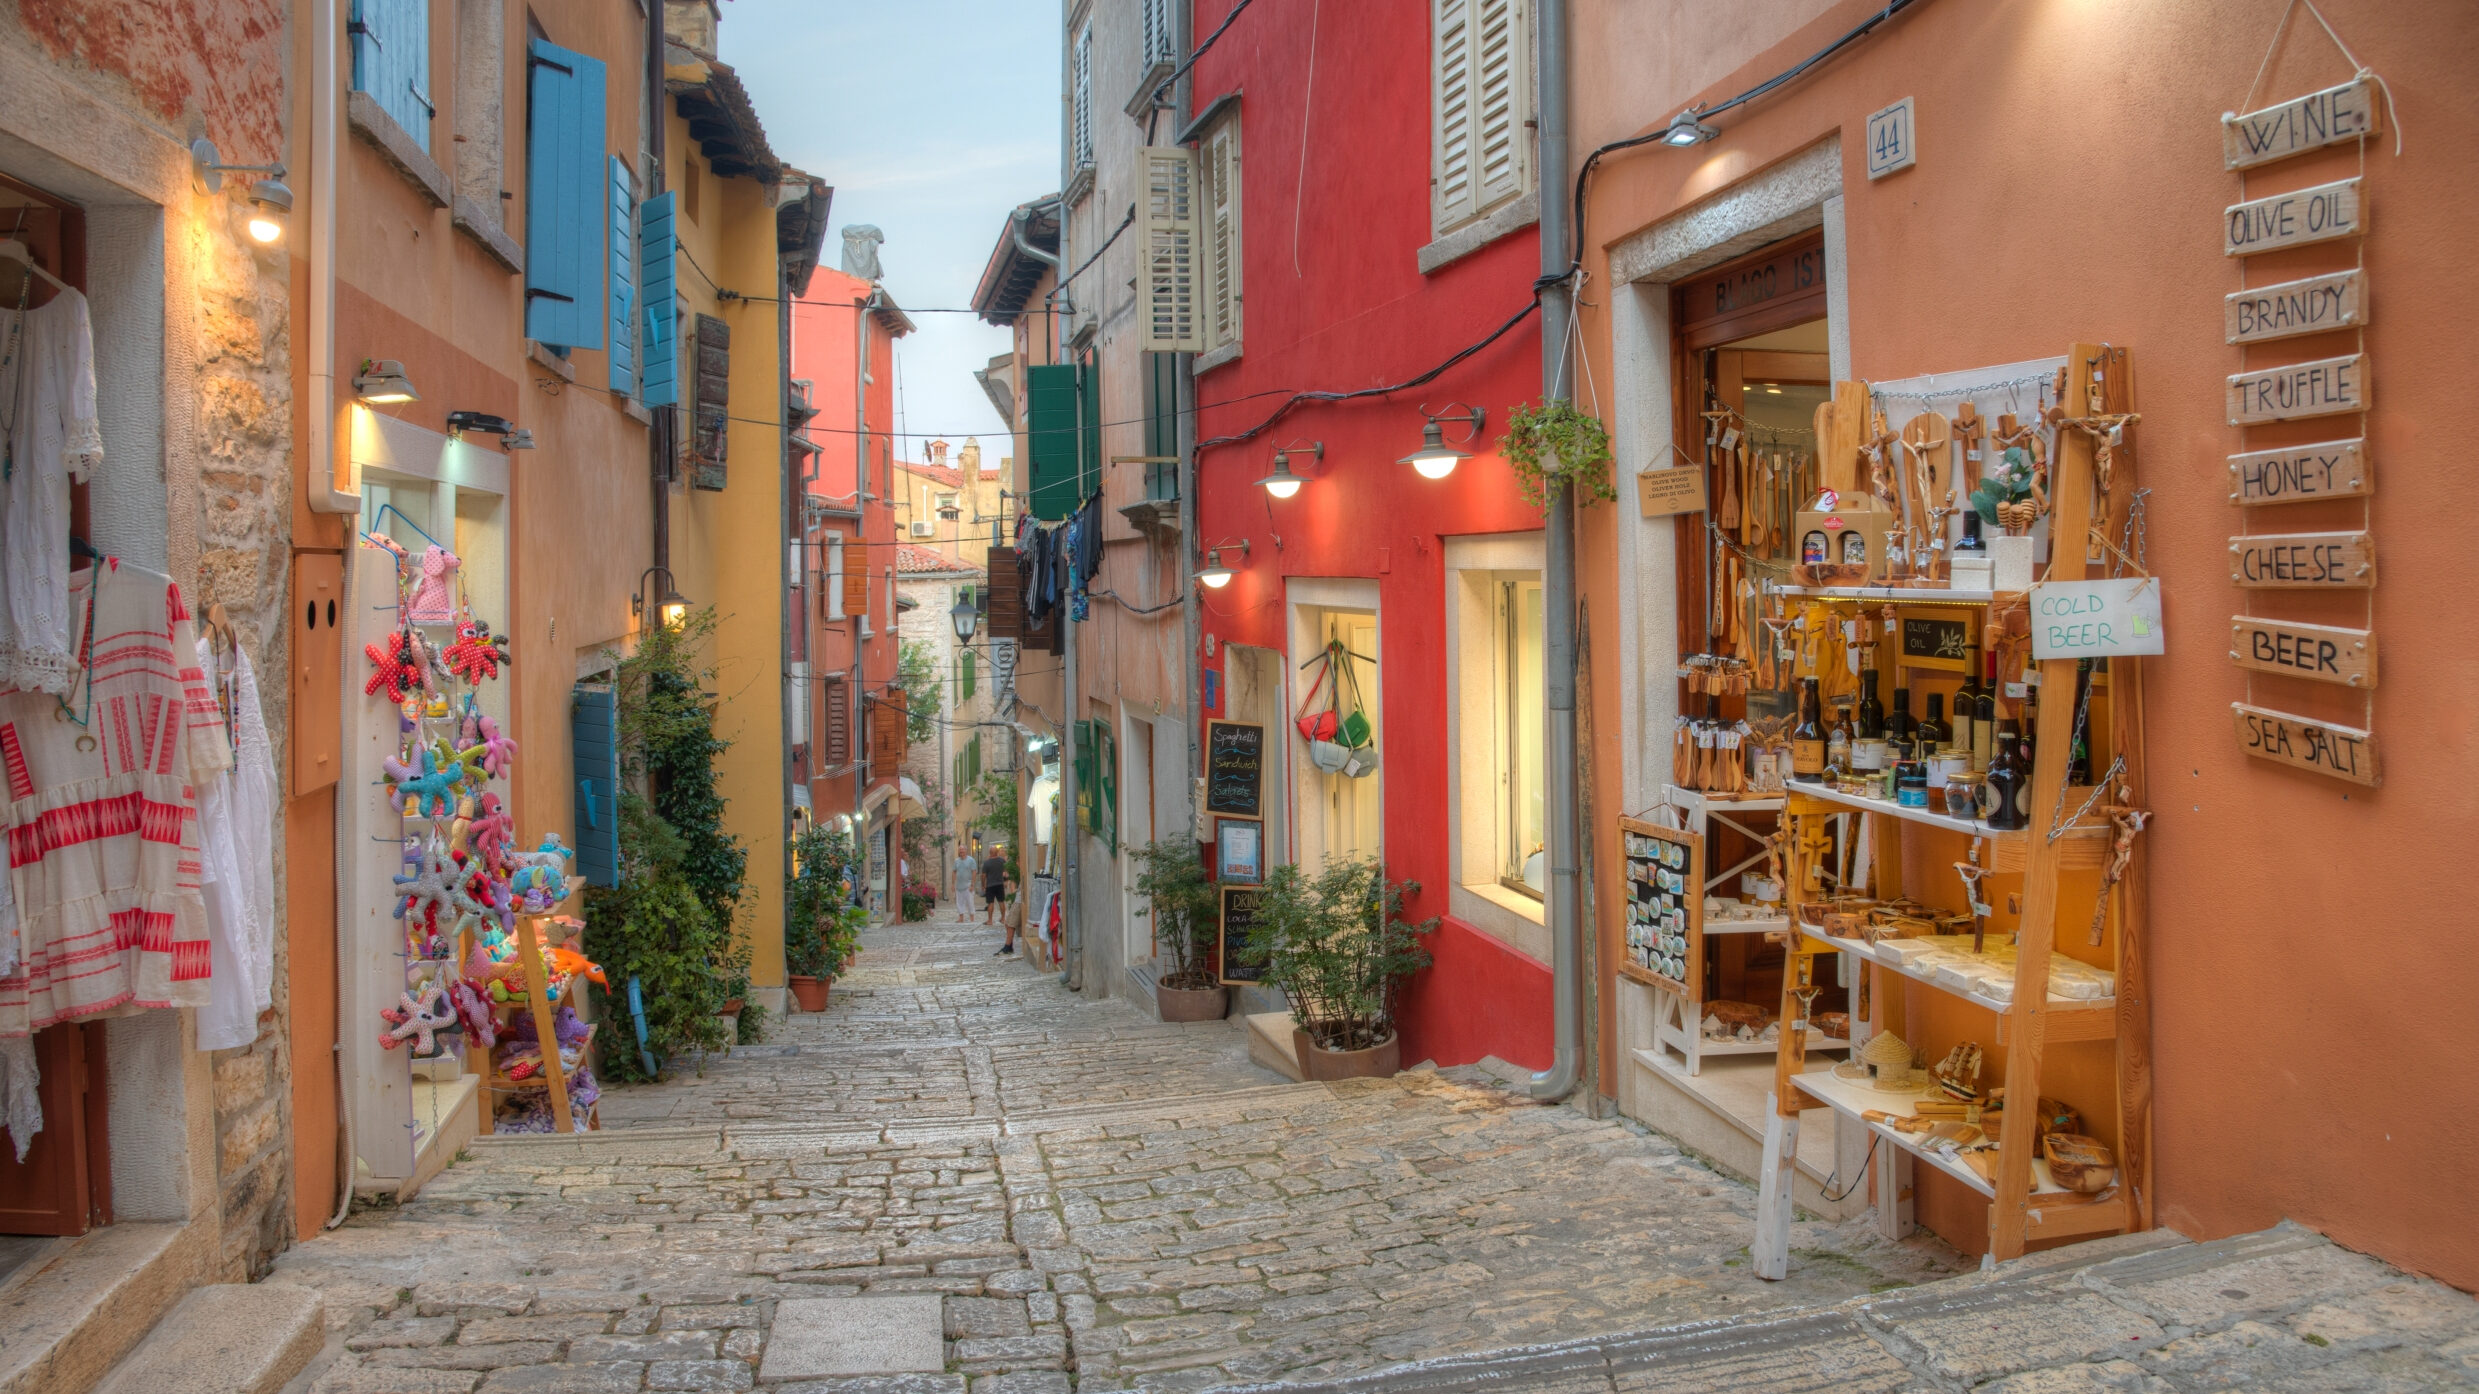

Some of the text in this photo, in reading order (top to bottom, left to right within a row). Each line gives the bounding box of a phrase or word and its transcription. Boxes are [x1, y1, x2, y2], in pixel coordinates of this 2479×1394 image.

[1876, 118, 1900, 160] 44
[2241, 87, 2353, 155] WINE
[2230, 193, 2350, 246] OLIVE OIL
[1716, 264, 1777, 314] BLAGO
[2238, 284, 2346, 335] BRANDY
[2234, 364, 2352, 414] TRUFFLE
[2243, 456, 2339, 497] HONEY
[2243, 545, 2346, 583] CHEESE
[2041, 594, 2104, 616] COLD
[1907, 621, 1932, 634] OLIVE
[1910, 638, 1926, 649] OIL
[2048, 622, 2119, 648] BEER
[2252, 630, 2339, 674] BEER
[1214, 727, 1257, 747] Spaghetti
[2247, 715, 2363, 776] SEA SALT
